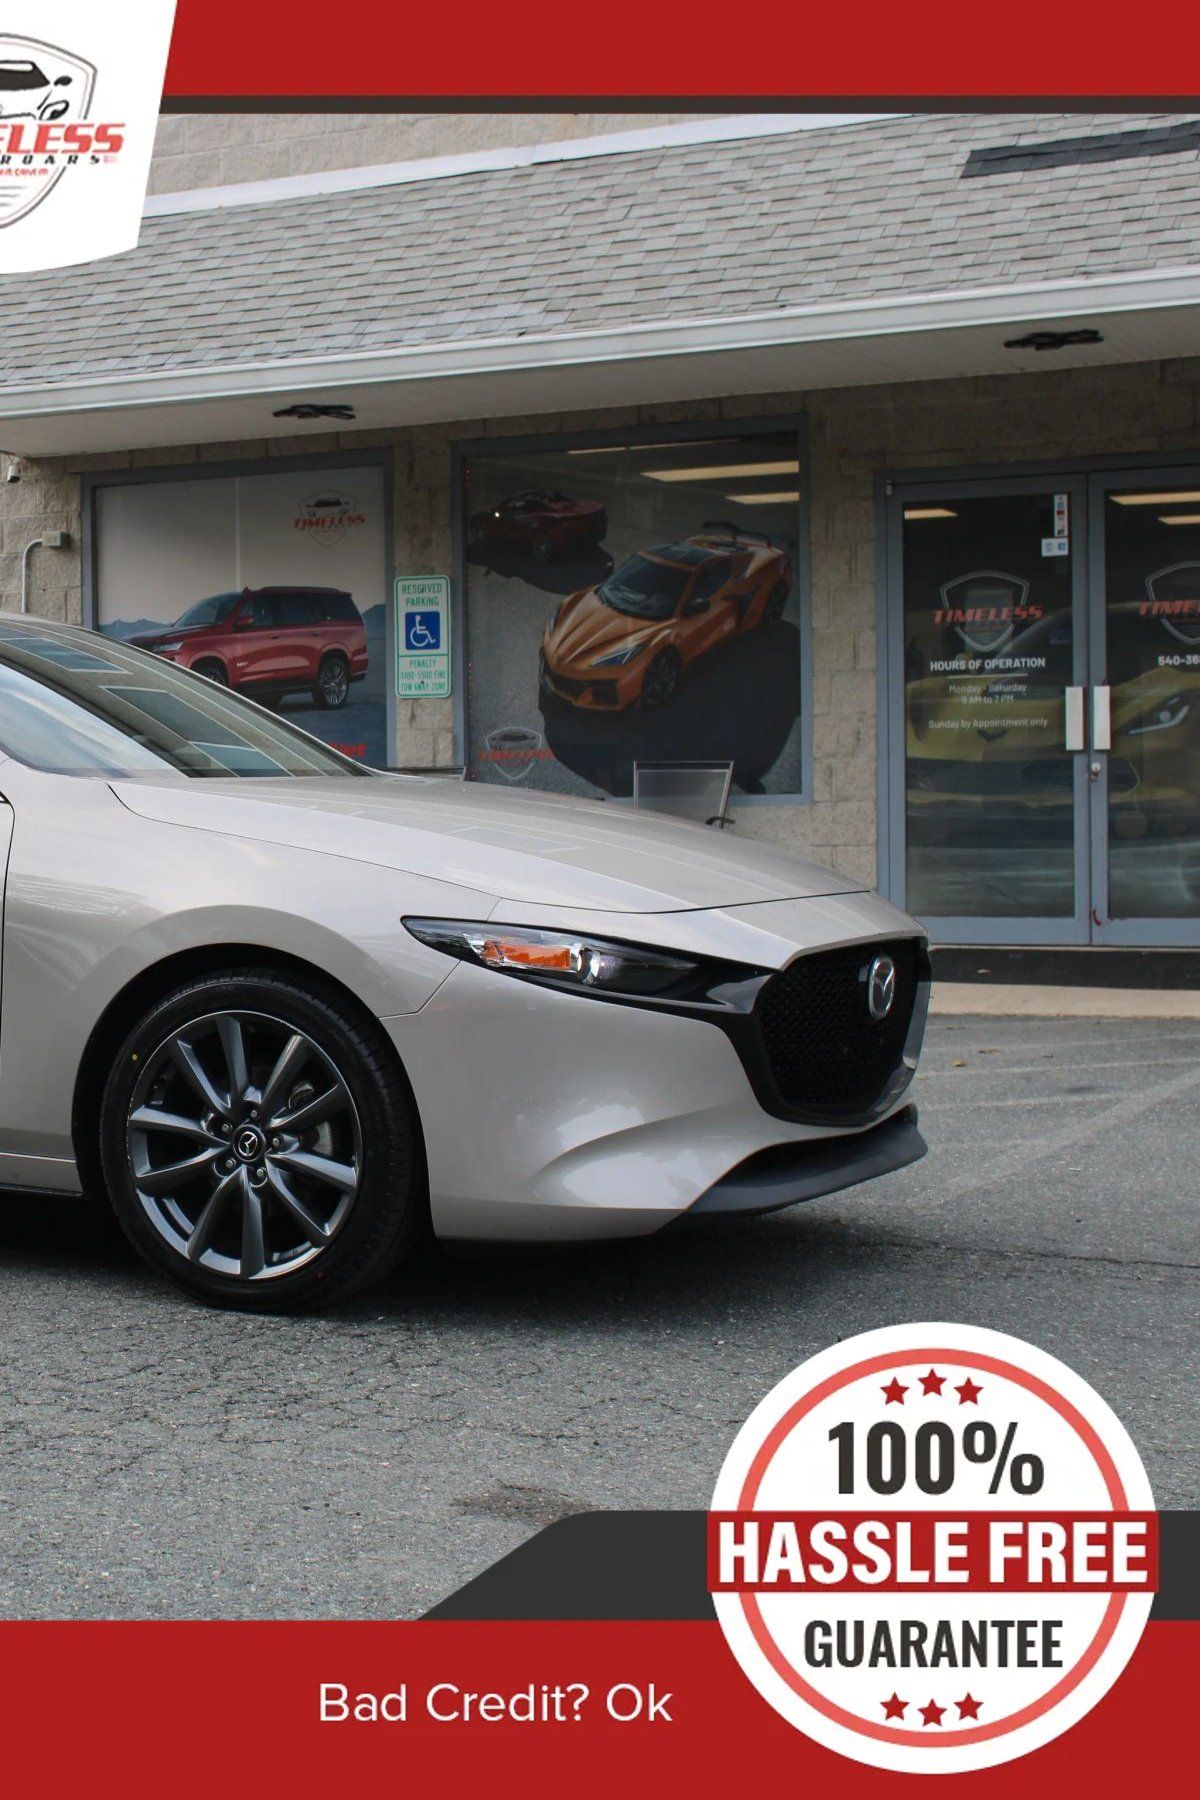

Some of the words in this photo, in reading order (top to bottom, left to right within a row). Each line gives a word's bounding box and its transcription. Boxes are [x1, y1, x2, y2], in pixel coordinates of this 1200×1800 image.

[402, 583, 442, 594] RESERVED
[406, 596, 439, 607] PARKING
[1139, 600, 1200, 615] TIME
[934, 605, 1043, 624] TIMELESS
[409, 659, 437, 668] PENALTY
[930, 660, 966, 671] HOURS
[968, 660, 982, 670] OF
[984, 657, 1045, 669] OPERATION
[1158, 654, 1200, 666] 540-36
[949, 684, 981, 695] Monday
[988, 683, 1027, 694] Saturday
[928, 719, 960, 730] Sunday
[961, 719, 970, 730] by
[973, 718, 1028, 729] Appointment
[1030, 717, 1049, 727] only
